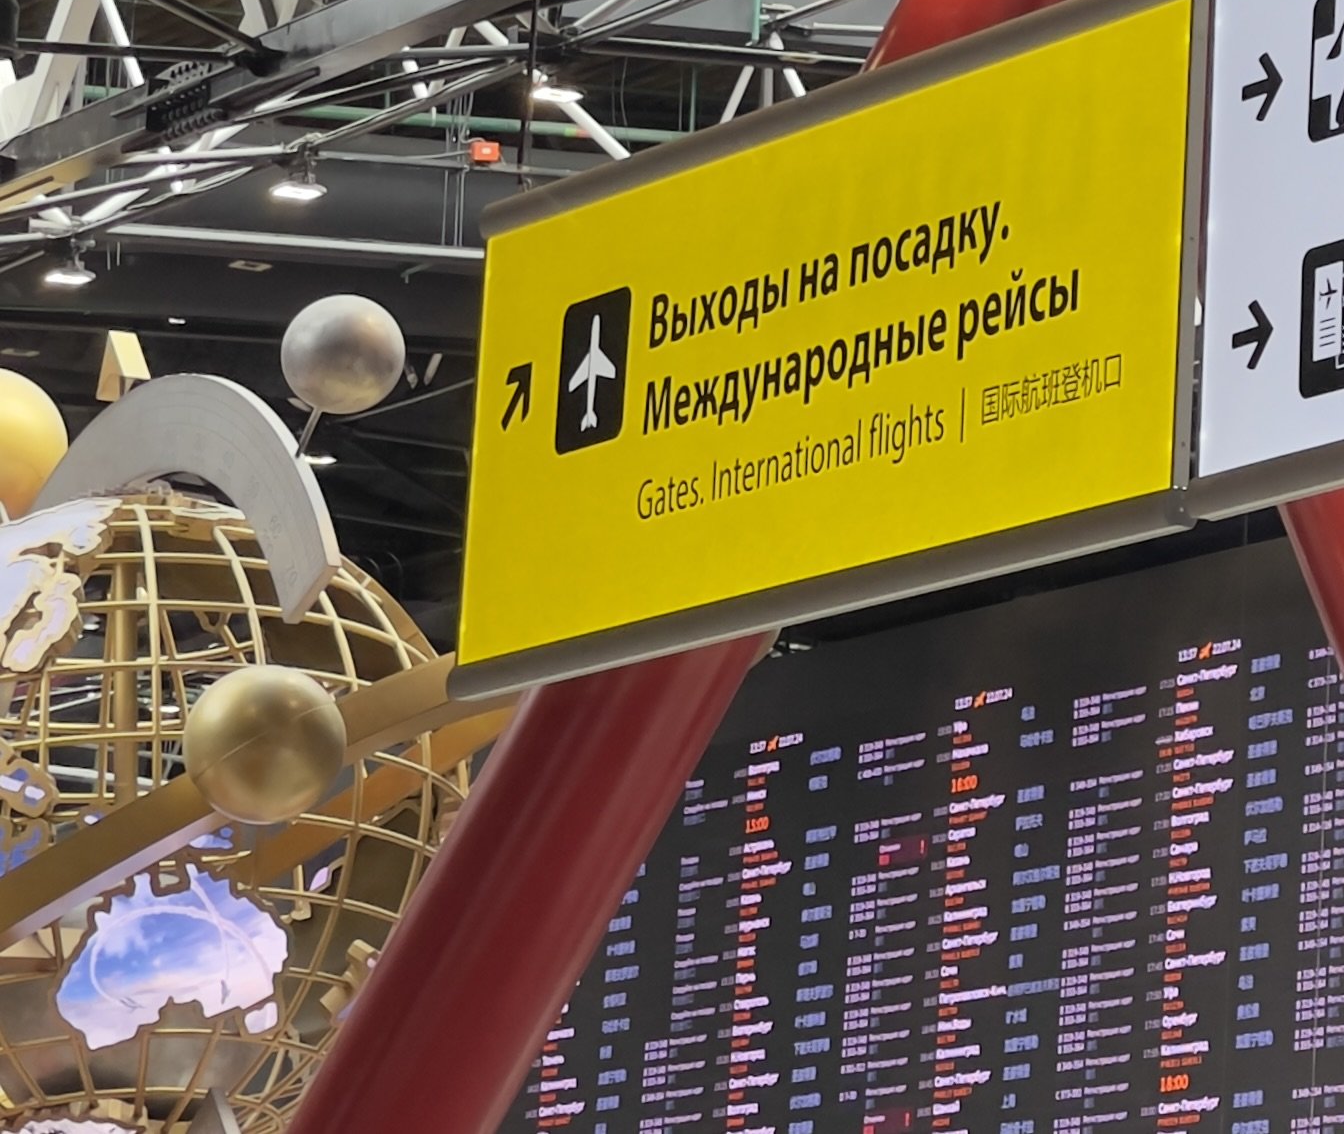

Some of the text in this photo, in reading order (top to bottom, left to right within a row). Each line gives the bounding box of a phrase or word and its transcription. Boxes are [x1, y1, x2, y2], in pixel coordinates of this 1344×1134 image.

[650, 201, 1008, 348] Выходы на посадку.
[643, 269, 1078, 435] Международные рейсы
[981, 354, 1122, 425] 国际航班登机口
[638, 405, 944, 521] Gates. International flights
[952, 775, 977, 792] 16:00
[746, 817, 768, 833] 15:00
[1161, 1074, 1188, 1092] 18:00
